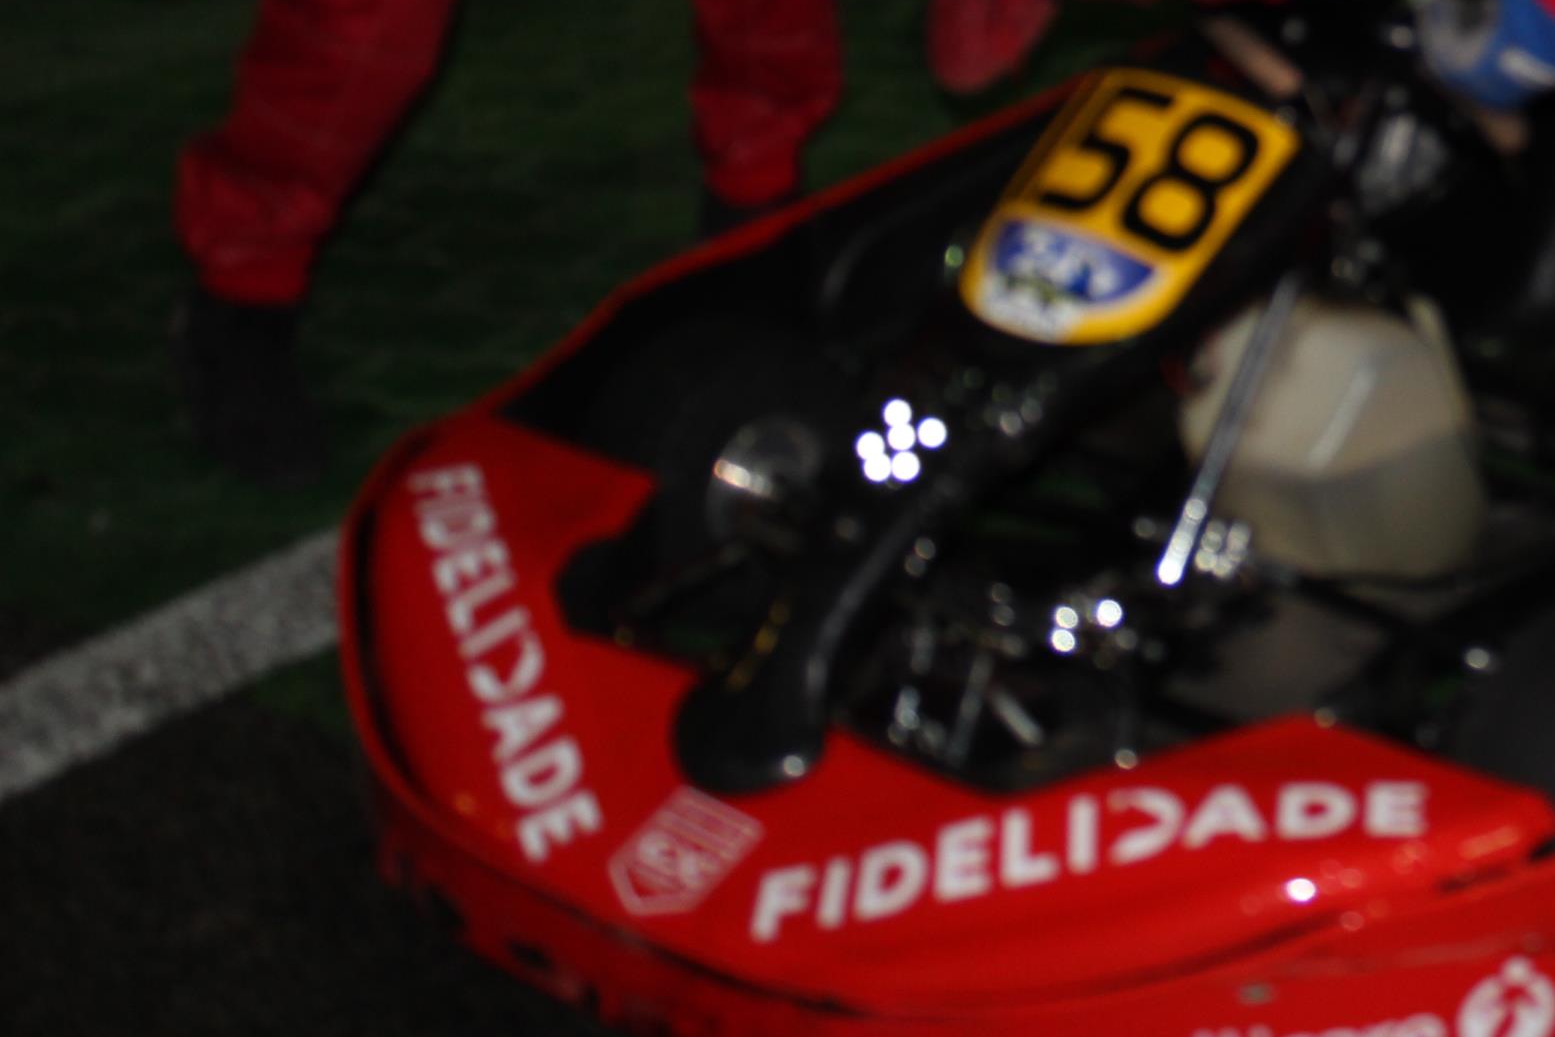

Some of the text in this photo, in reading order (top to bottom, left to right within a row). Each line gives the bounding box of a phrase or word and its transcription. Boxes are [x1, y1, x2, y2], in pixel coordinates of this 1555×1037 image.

[1040, 86, 1258, 250] 58
[408, 460, 605, 866] FIDELIDADE
[750, 779, 1431, 944] FIDELIDADE
